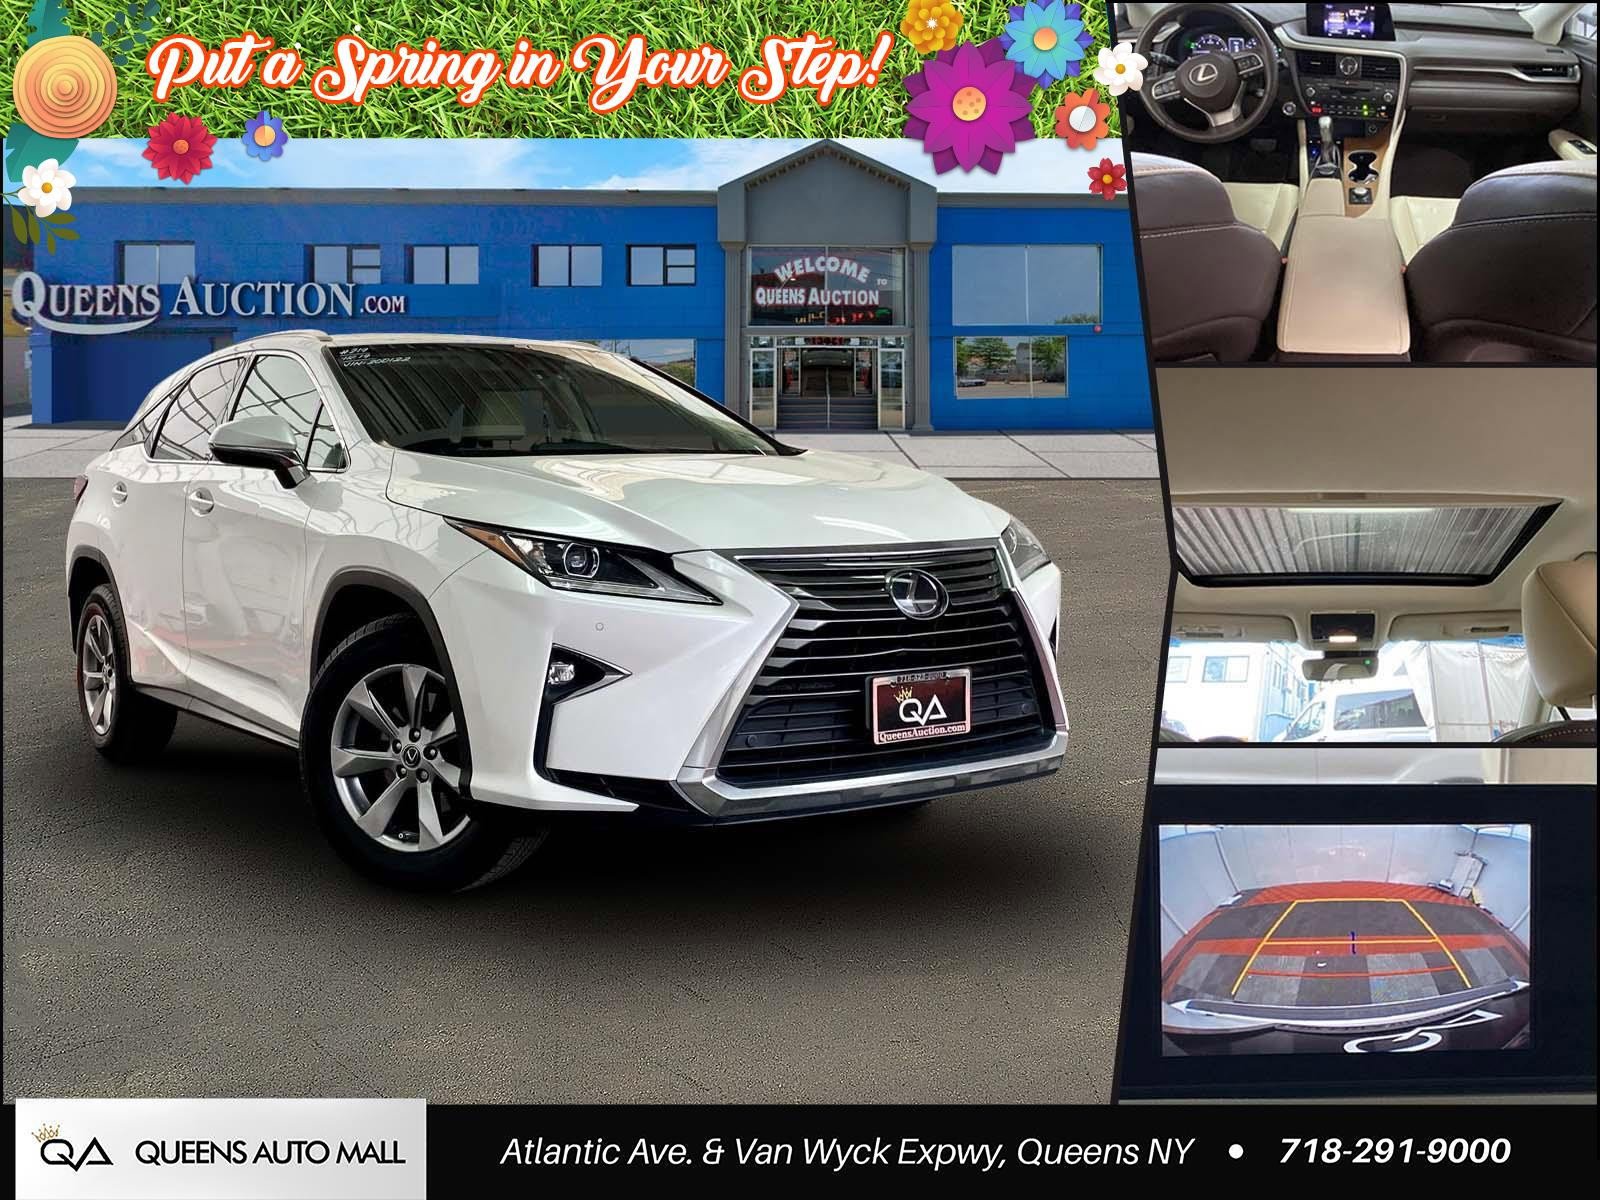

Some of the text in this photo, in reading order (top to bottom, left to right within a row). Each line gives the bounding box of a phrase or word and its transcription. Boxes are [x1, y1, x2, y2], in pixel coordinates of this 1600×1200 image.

[773, 256, 871, 283] WELCOME
[11, 271, 160, 335] QUEENS
[755, 287, 880, 305] QUEENS AUCTION
[899, 694, 948, 726] QA
[880, 724, 965, 742] QueensAuction.com
